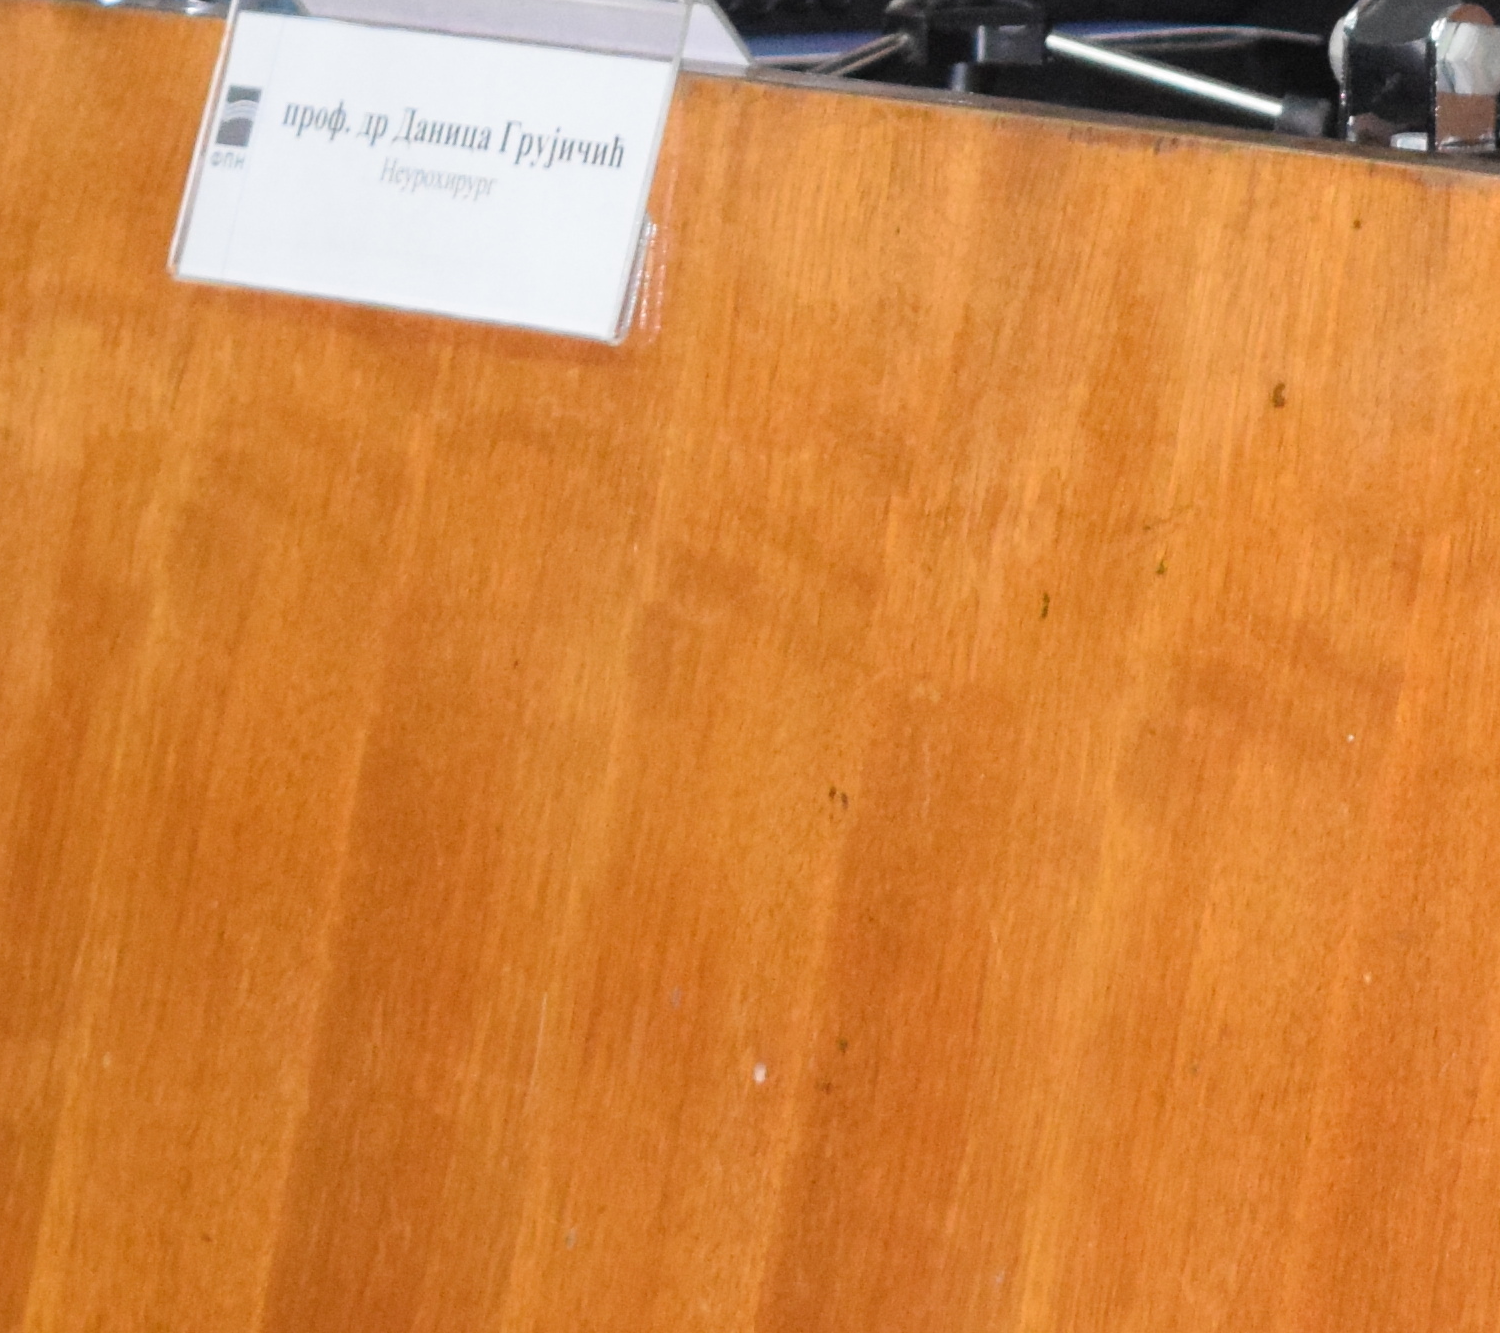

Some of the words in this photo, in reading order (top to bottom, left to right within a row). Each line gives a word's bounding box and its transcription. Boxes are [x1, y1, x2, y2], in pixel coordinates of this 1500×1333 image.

[282, 98, 351, 141] проф.
[357, 111, 389, 147] др
[392, 107, 493, 153] Даница
[499, 120, 625, 169] Грујичић
[210, 150, 246, 170] ФПН
[379, 157, 499, 202] Неурохирург
